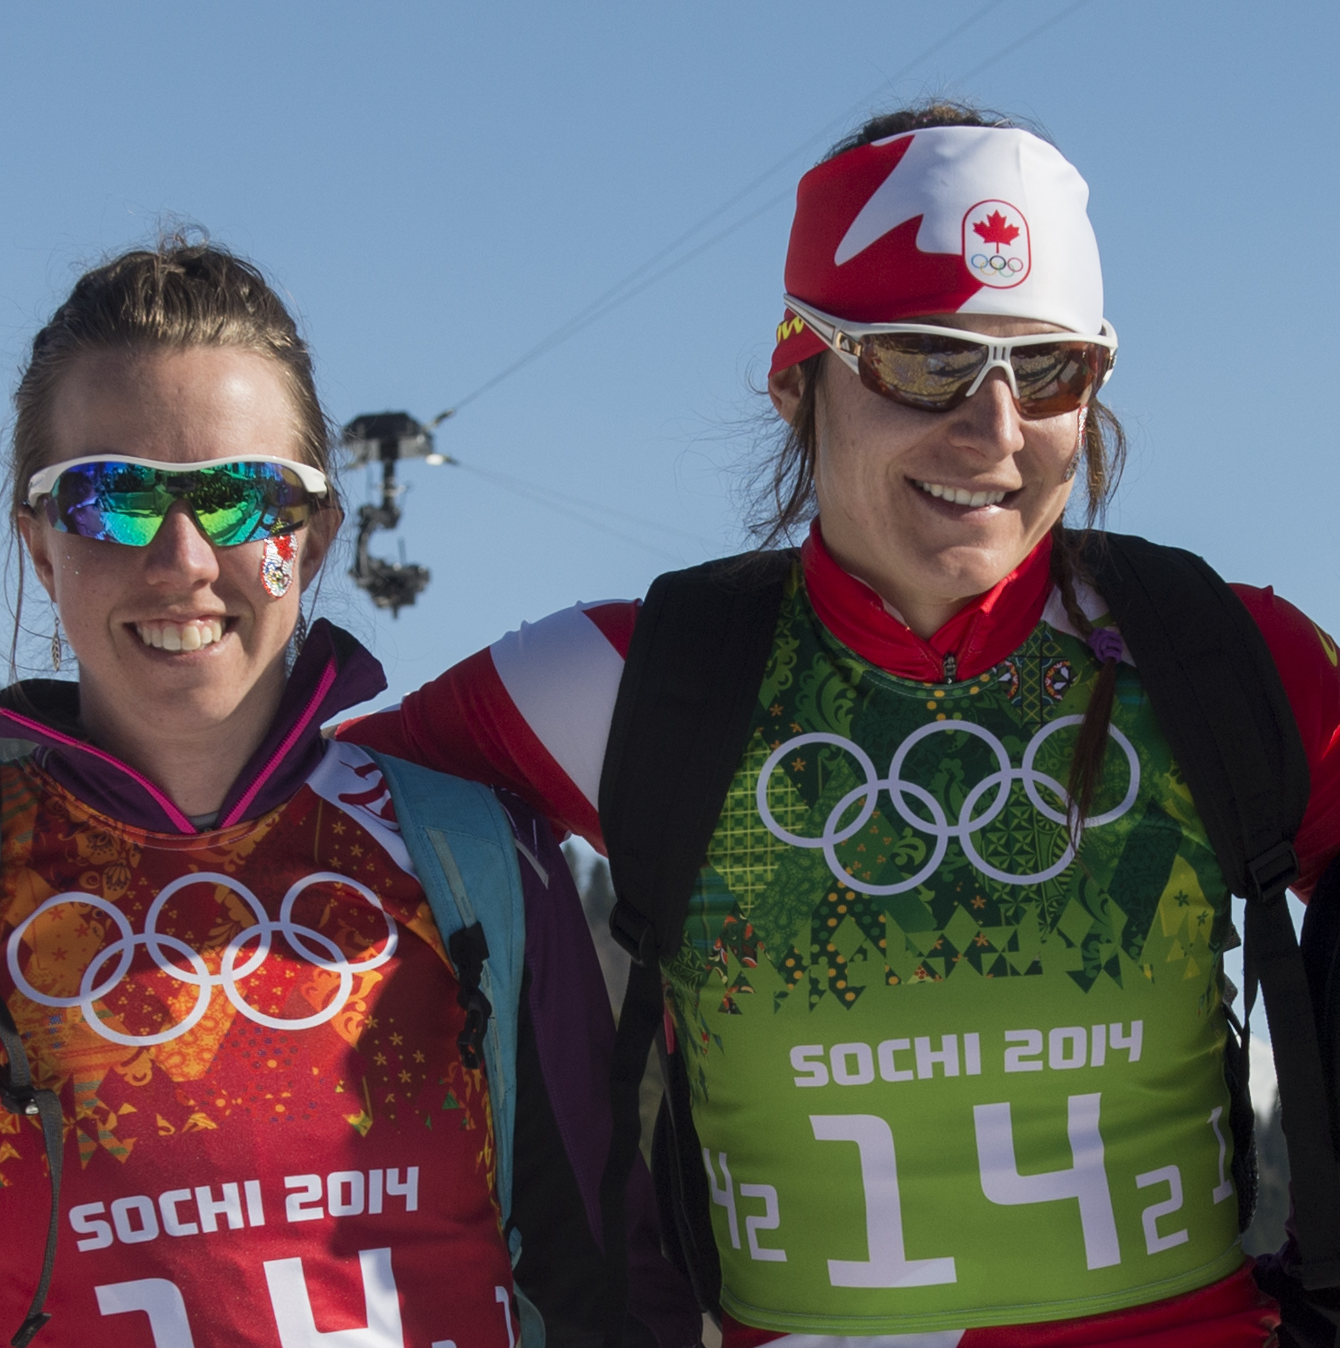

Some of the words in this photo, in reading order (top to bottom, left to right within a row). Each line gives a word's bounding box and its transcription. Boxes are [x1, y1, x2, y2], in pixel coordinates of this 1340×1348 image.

[788, 1031, 982, 1088] SOCHI
[1003, 1019, 1144, 1073] 2014
[68, 1179, 266, 1253] SOCHI
[283, 1165, 420, 1223] 2014
[808, 1091, 1122, 1289] 14
